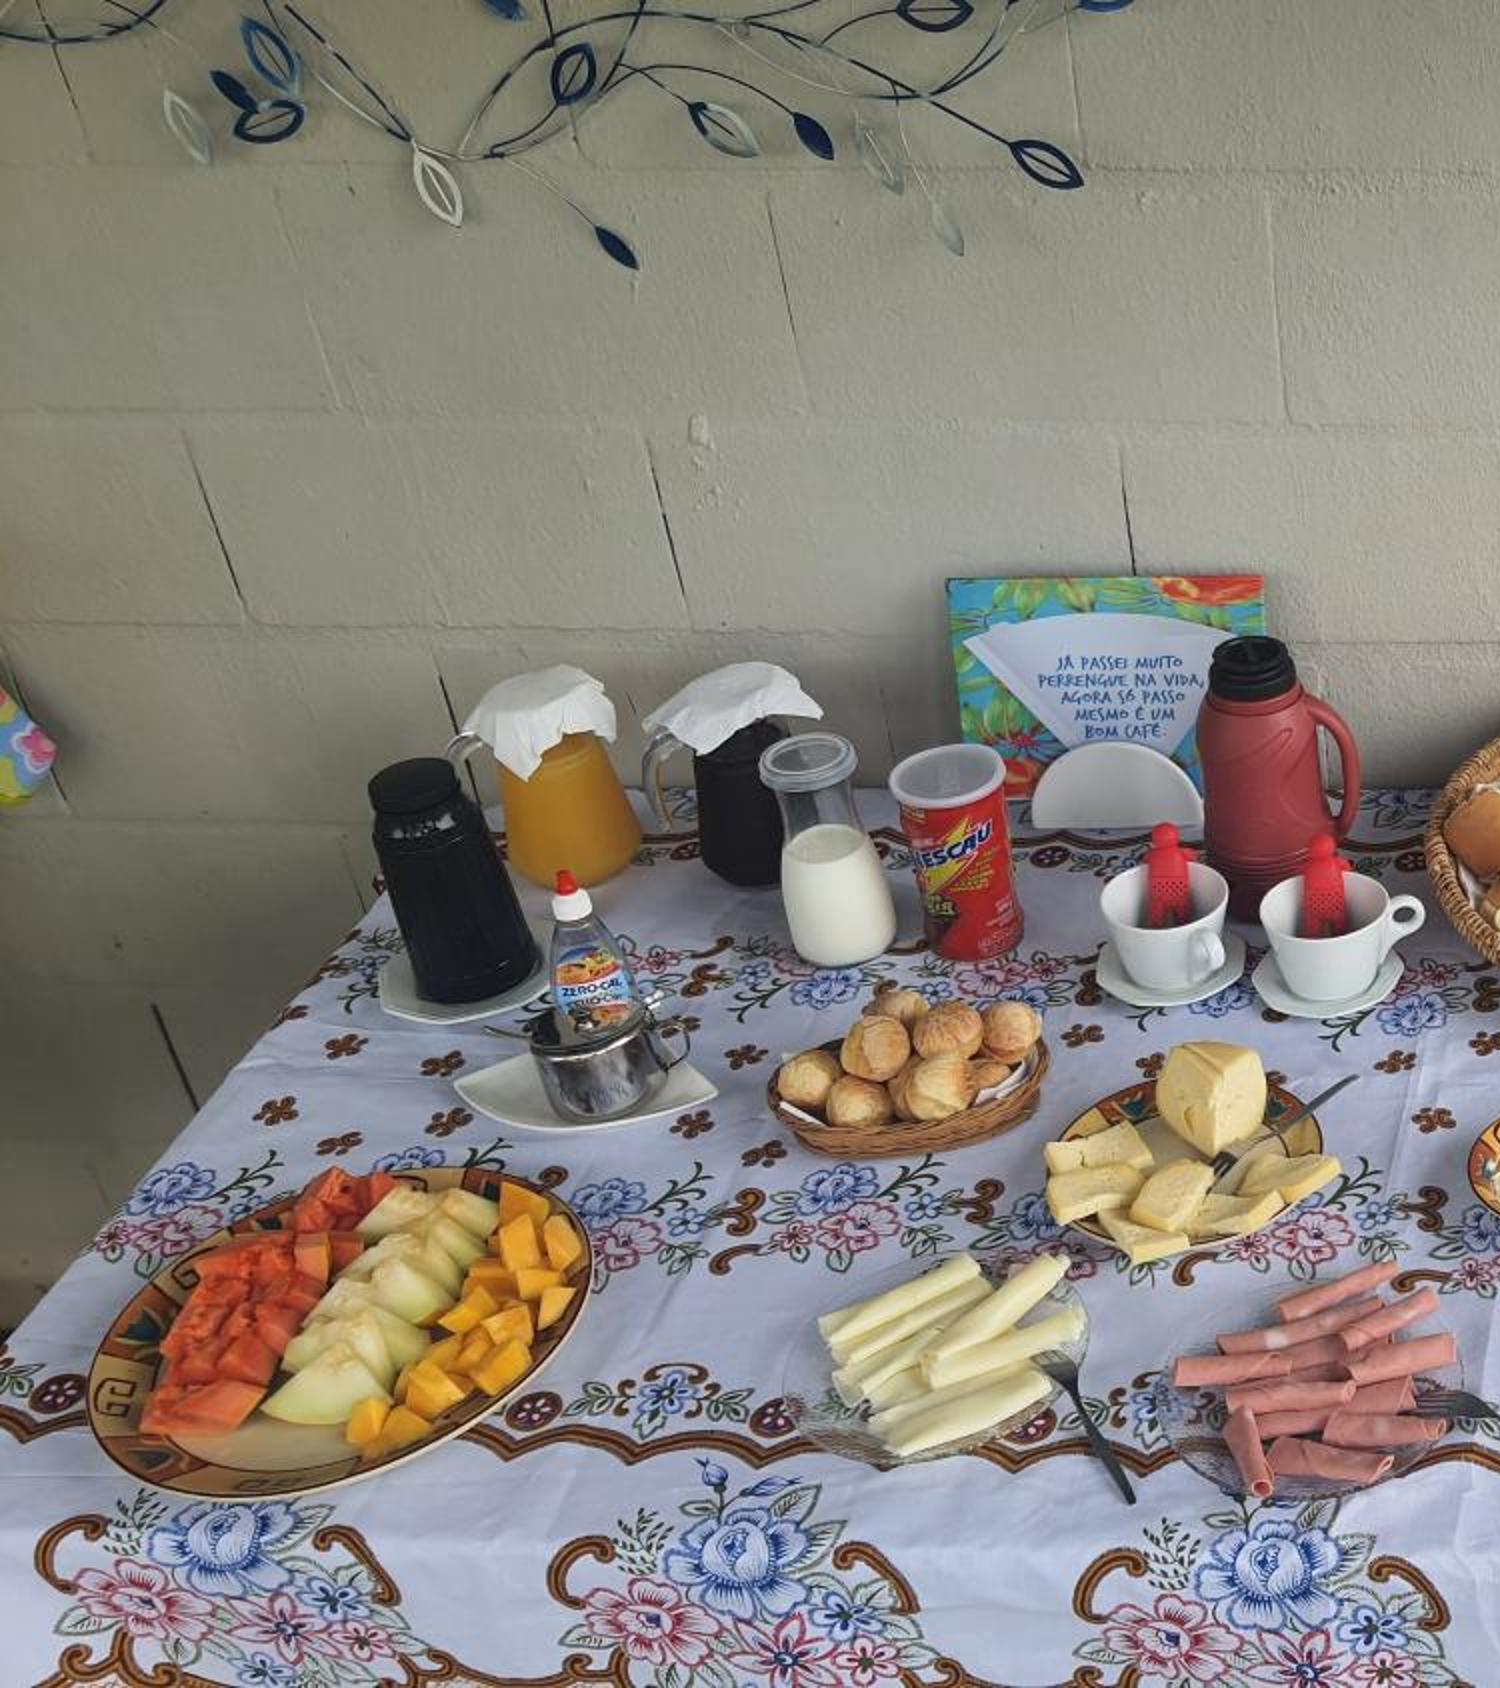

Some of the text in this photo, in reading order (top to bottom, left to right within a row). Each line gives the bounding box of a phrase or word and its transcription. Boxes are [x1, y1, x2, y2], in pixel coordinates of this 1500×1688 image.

[1056, 654, 1183, 671] JÁ PASSEI MUITO
[1037, 672, 1205, 689] PERRENGUE NA VIDA,
[1061, 688, 1186, 705] AGORA SÓ PASSO
[1074, 706, 1175, 722] MESMO É UM
[1084, 723, 1168, 739] BOM CAFÉ.
[561, 977, 624, 997] ZERO-CAL
